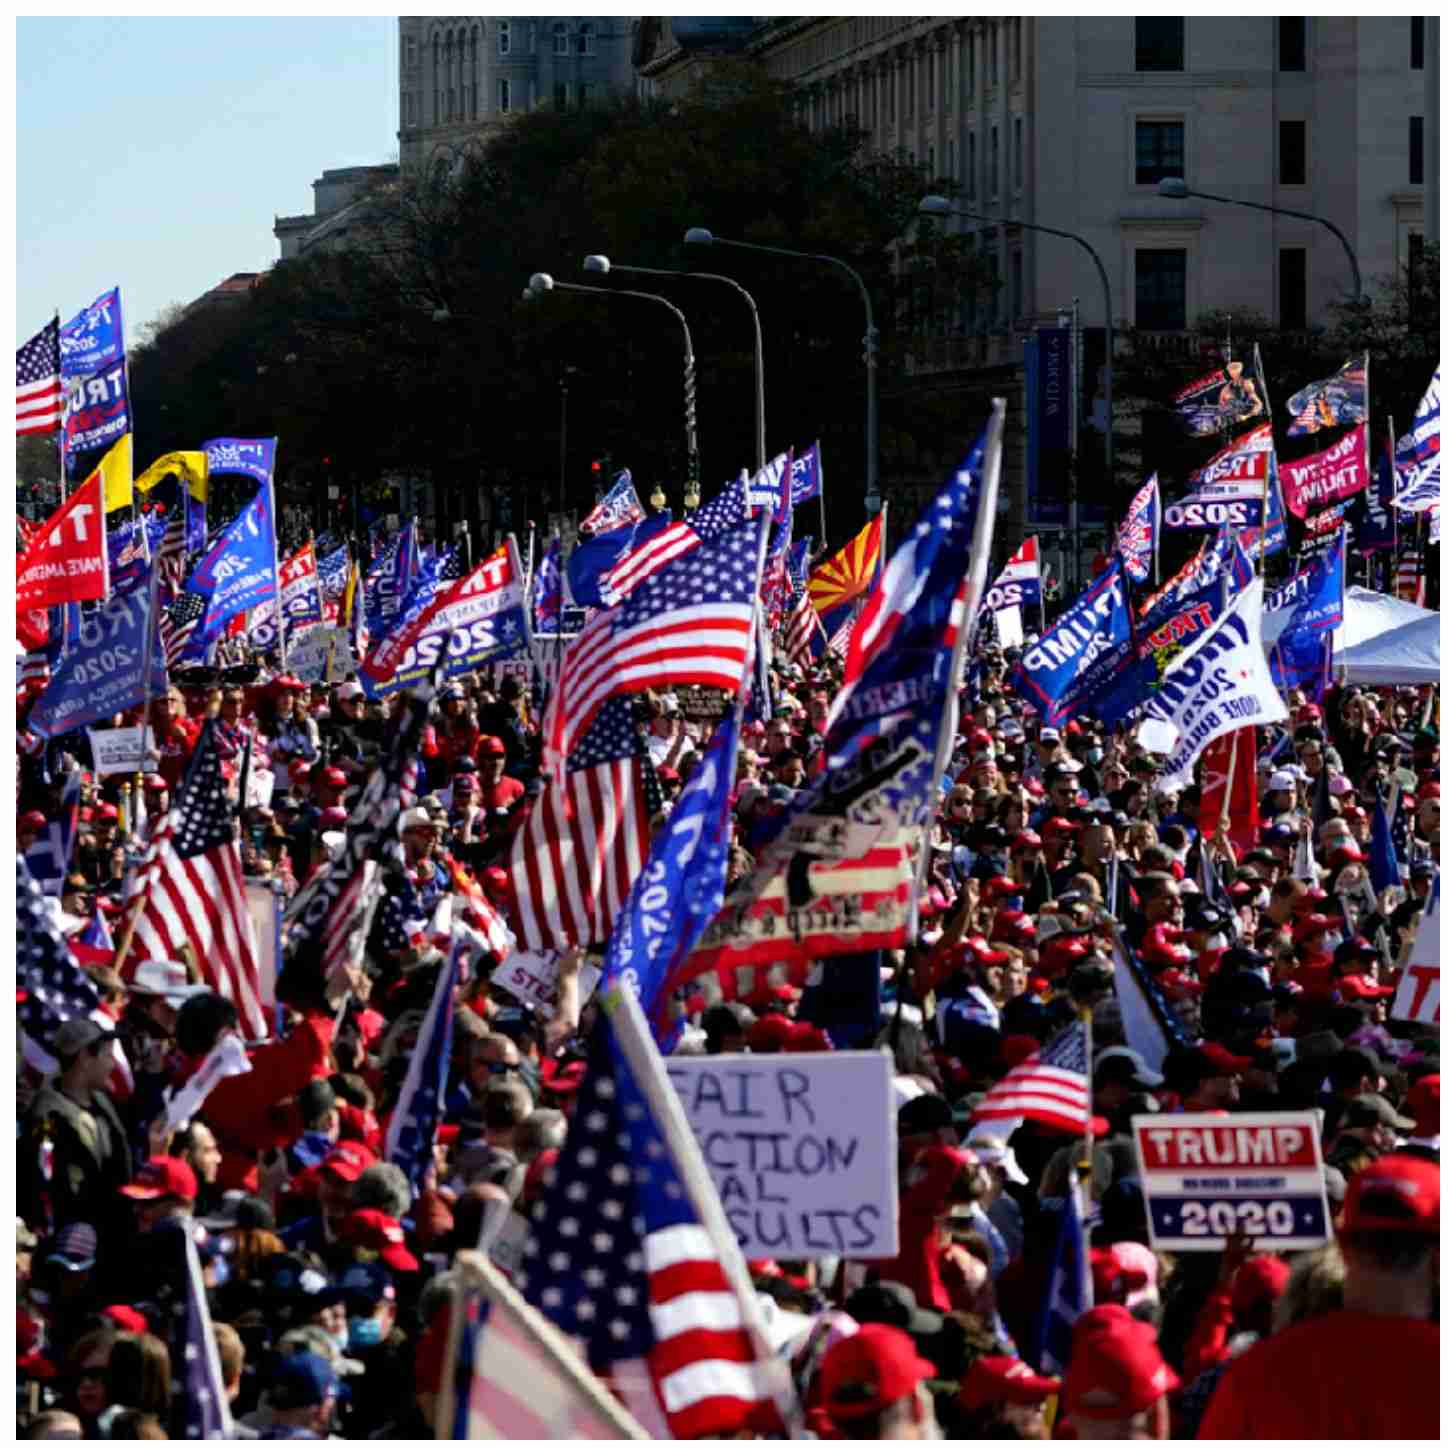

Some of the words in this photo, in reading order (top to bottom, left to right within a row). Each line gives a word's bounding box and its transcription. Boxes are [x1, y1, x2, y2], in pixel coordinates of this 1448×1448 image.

[702, 1131, 858, 1175] CTION
[1147, 1127, 1304, 1165] TRUMP
[719, 1173, 789, 1204] AL
[727, 1203, 881, 1253] SULTS
[1179, 1201, 1295, 1236] 2020
